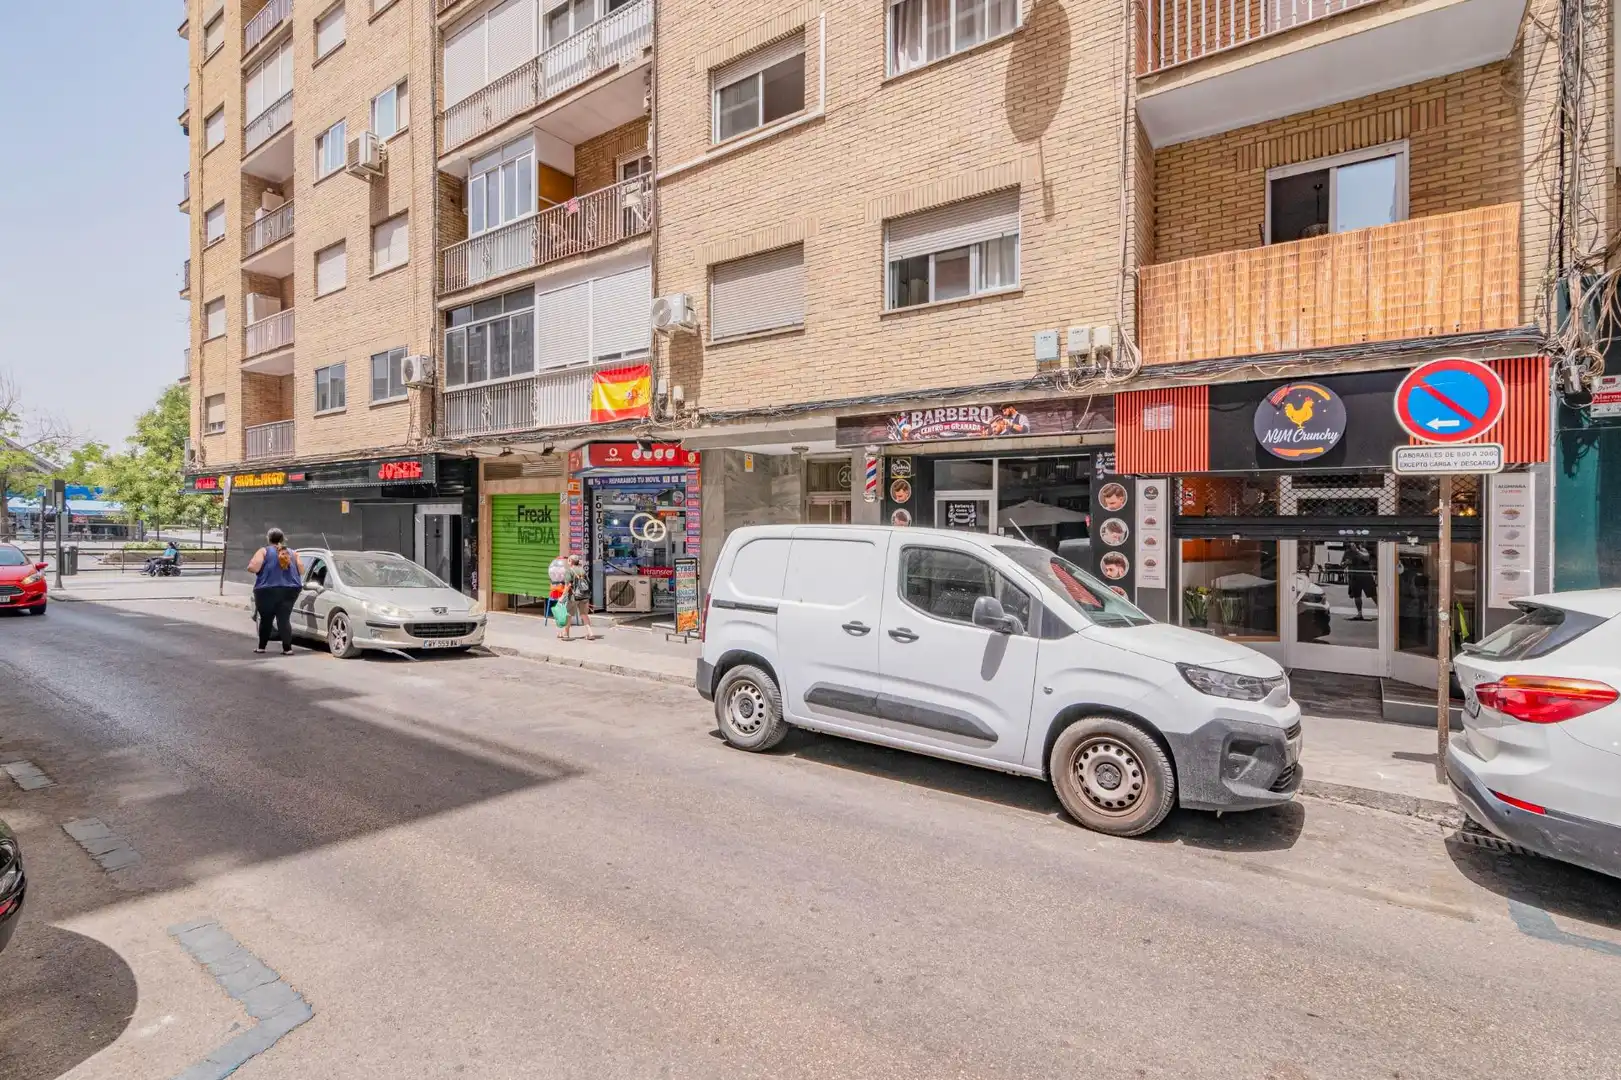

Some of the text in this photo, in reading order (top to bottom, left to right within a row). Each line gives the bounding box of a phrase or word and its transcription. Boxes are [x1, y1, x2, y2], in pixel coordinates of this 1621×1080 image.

[911, 406, 994, 428] BARBERO
[921, 424, 943, 434] CENTRO
[951, 423, 980, 431] GRANADA
[1263, 428, 1339, 444] NYM Crunchy
[378, 461, 423, 480] JOKER
[517, 504, 553, 523] Freak
[517, 526, 556, 545] MEDIA
[595, 495, 603, 560] FOTOCOPIA
